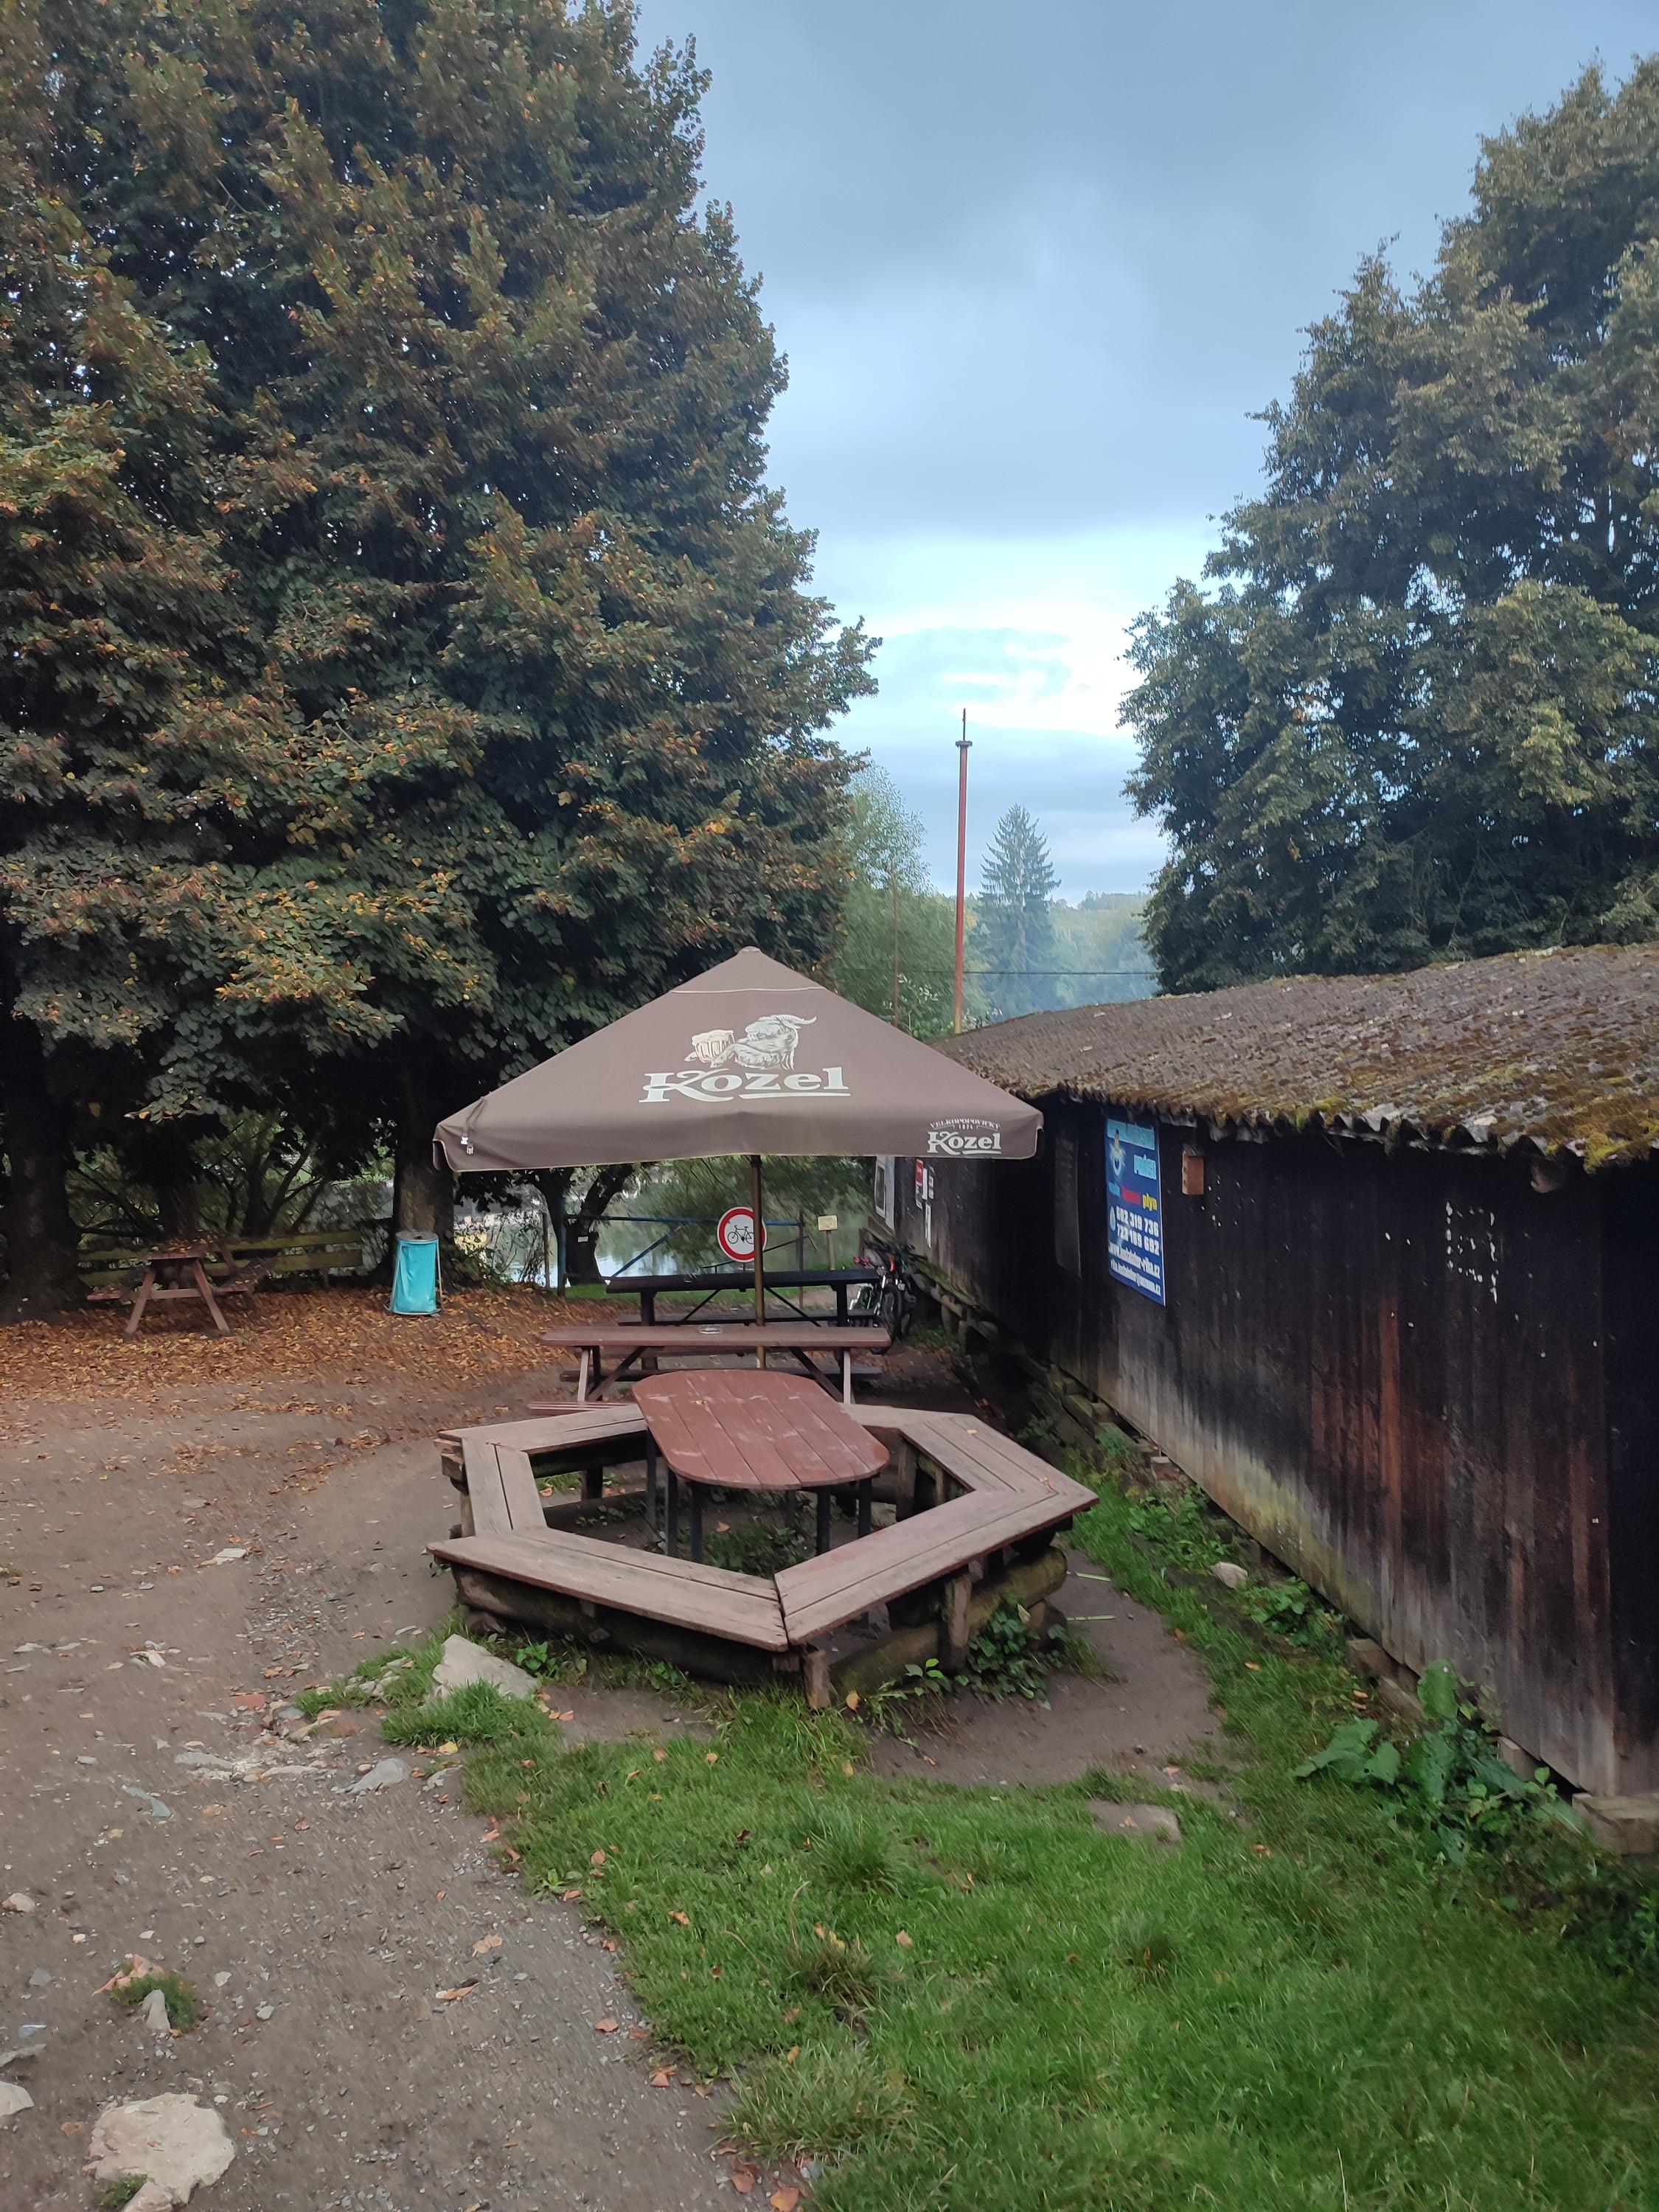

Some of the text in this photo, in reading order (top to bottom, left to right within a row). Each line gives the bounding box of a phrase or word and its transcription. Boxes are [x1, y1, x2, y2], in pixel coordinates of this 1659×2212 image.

[639, 1066, 850, 1102] Kozel
[927, 1130, 1001, 1155] Kozel
[1142, 1192, 1158, 1211] plyn
[1144, 1217, 1159, 1238] 736
[1144, 1236, 1160, 1256] 692
